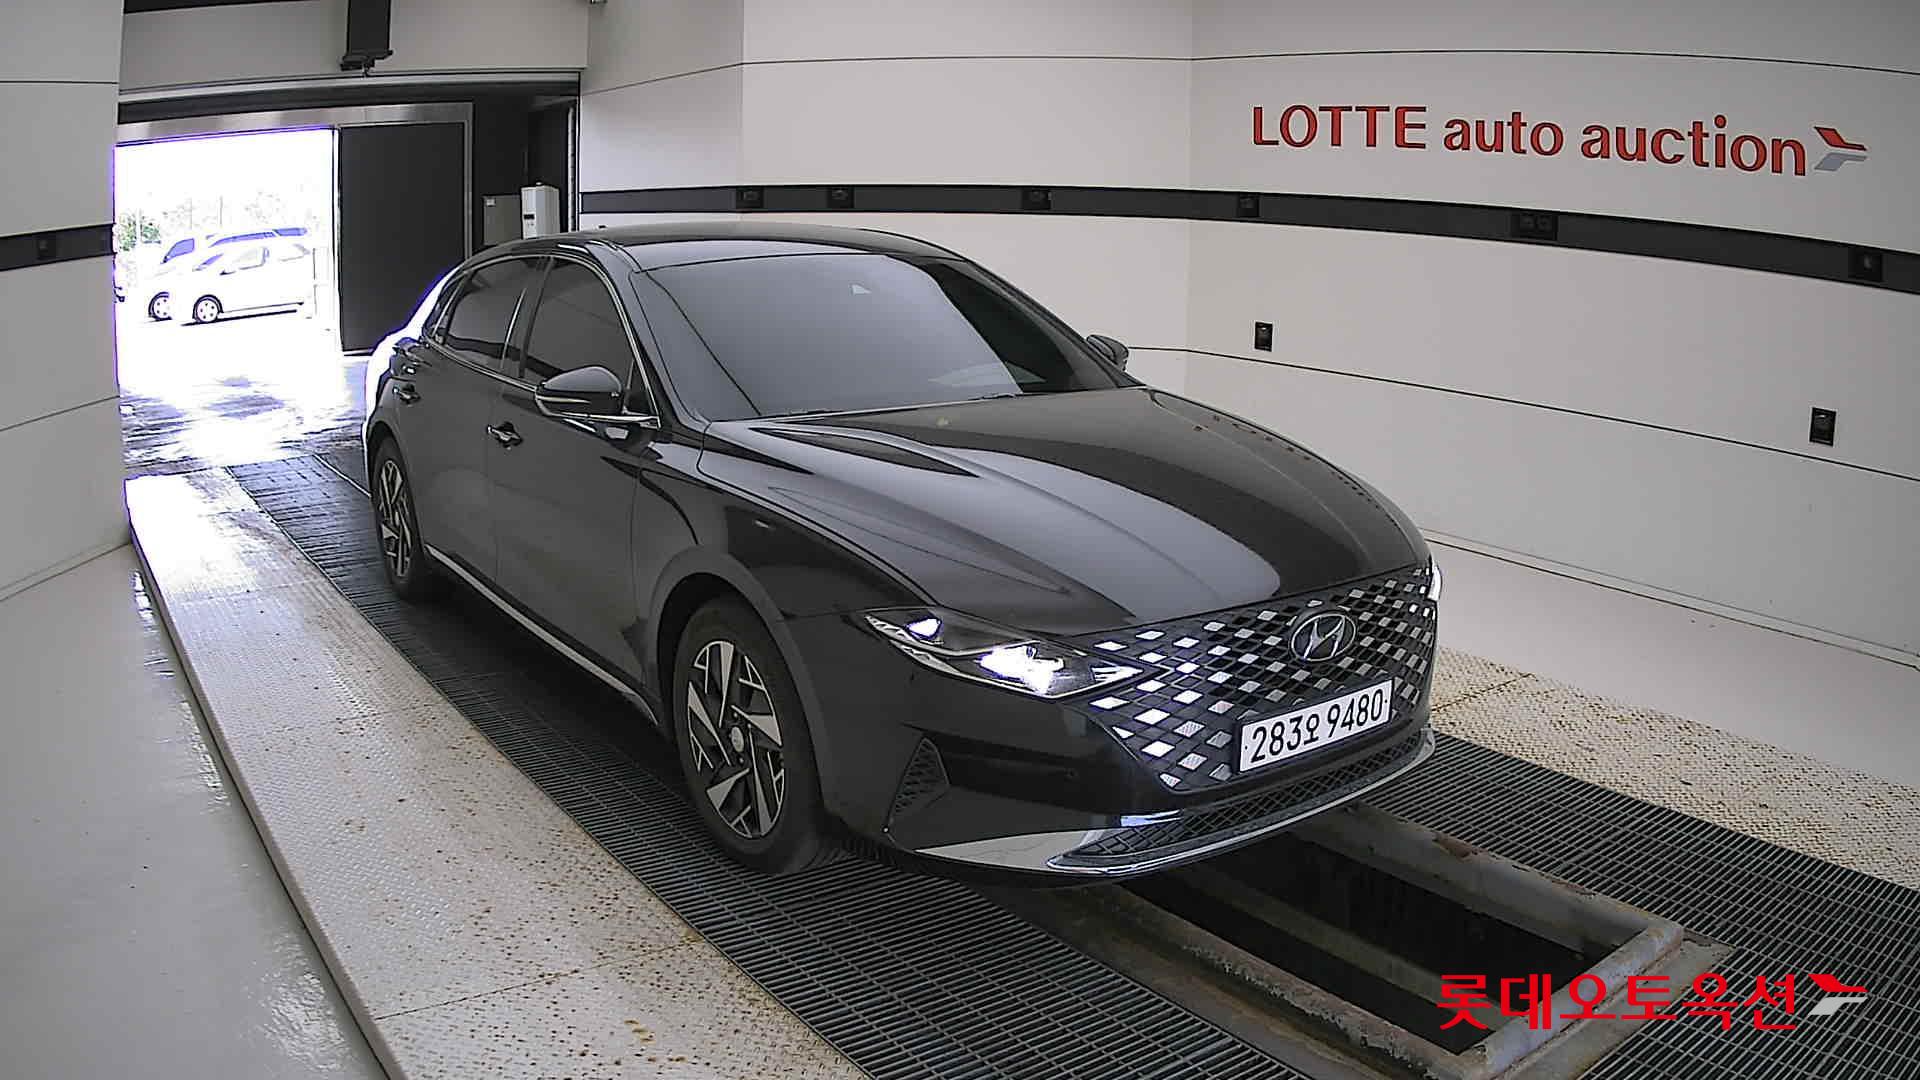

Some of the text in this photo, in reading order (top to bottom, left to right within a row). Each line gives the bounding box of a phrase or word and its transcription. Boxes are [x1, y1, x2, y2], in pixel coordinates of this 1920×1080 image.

[1252, 105, 1807, 176] LOTTE auto auction
[1249, 688, 1383, 764] 283오 9480
